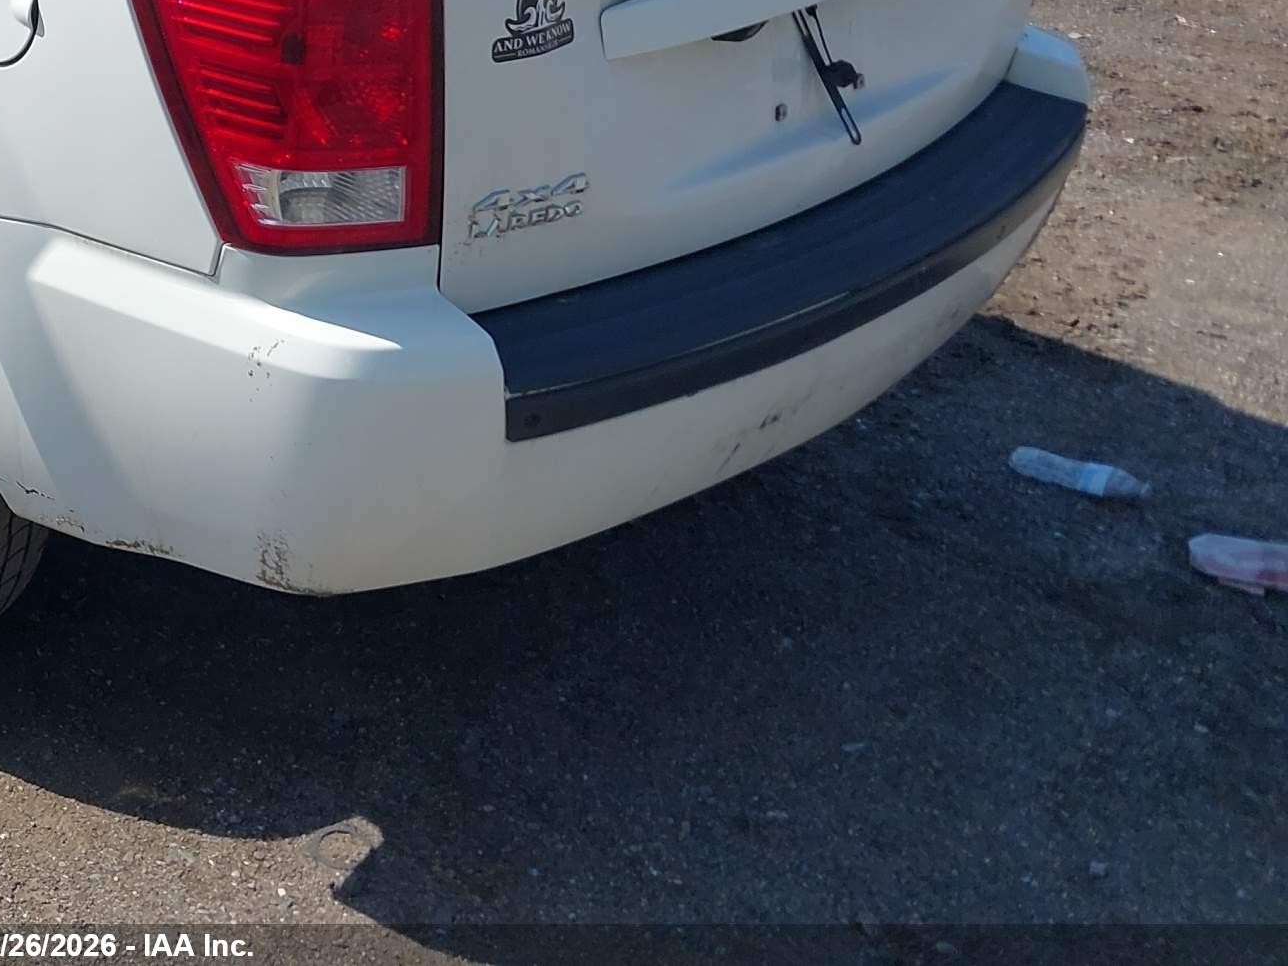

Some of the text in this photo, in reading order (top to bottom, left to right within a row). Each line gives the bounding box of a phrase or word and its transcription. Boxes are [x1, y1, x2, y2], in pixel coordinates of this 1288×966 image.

[493, 37, 524, 53] AND
[526, 32, 546, 46] WE
[546, 20, 571, 42] KNOW
